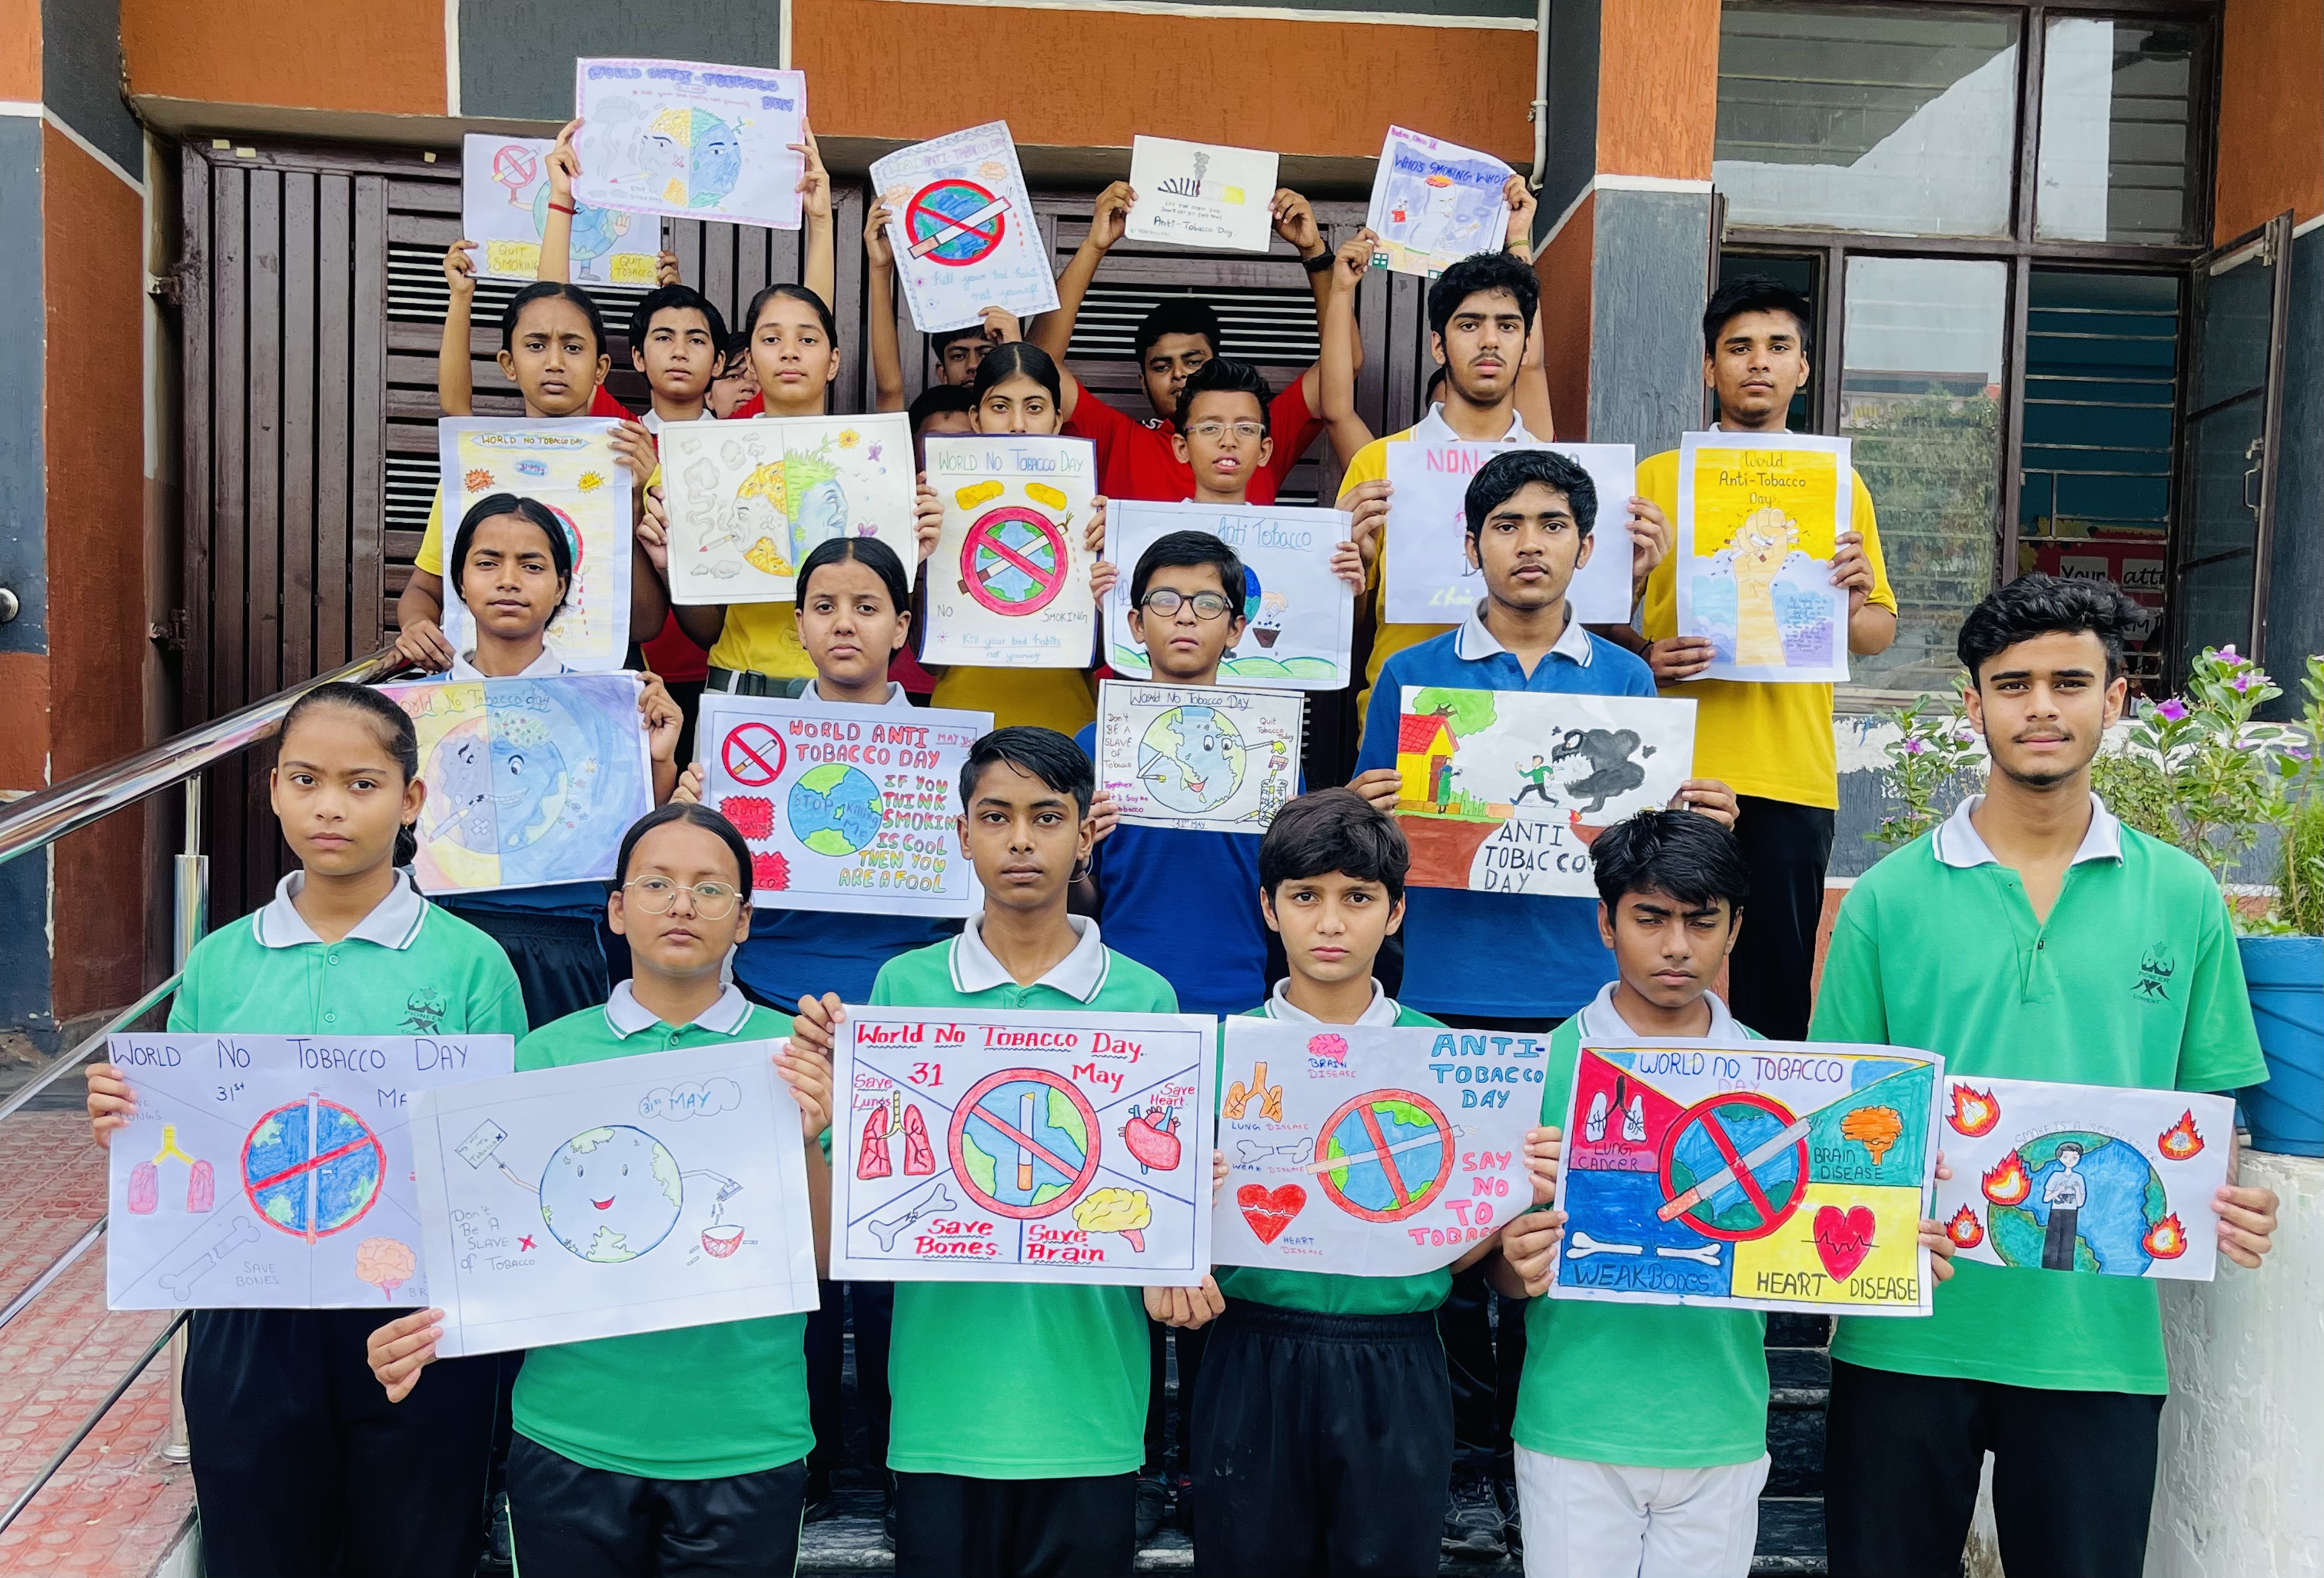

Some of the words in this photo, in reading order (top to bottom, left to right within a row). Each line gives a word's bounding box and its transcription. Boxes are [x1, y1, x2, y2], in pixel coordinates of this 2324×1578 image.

[588, 65, 642, 80] WORLD
[761, 97, 795, 112] DAY
[889, 158, 923, 174] WORLD
[1430, 162, 1472, 181] SMOKING
[498, 245, 525, 255] QUIT
[620, 256, 641, 265] QUIT
[615, 268, 653, 278] TOBACCO
[933, 271, 953, 285] Kill
[961, 275, 986, 290] your
[481, 434, 517, 444] WORLD
[939, 451, 977, 471] WORLD
[986, 451, 1002, 471] NO
[1009, 449, 1056, 471] TOBACCO
[1060, 451, 1083, 472] DAY
[1742, 452, 1783, 468] World
[1750, 493, 1777, 508] Day
[1216, 516, 1248, 545] Anti
[1252, 518, 1312, 548] Tobacco
[937, 605, 953, 617] NO
[1040, 608, 1087, 624] SMOKING
[963, 634, 979, 645] Kill
[985, 638, 1006, 650] your
[1012, 635, 1027, 645] bad
[1033, 634, 1061, 645] habits
[1006, 652, 1041, 665] yourself
[394, 694, 434, 713] orld
[447, 693, 461, 709] No
[467, 689, 523, 705] Tobacco
[1167, 692, 1181, 703] No
[1186, 693, 1222, 705] Tobacco
[1228, 695, 1249, 711] DAY
[1107, 713, 1129, 722] Don't
[790, 720, 860, 741] WORLD
[872, 724, 929, 748] ANTI
[1105, 724, 1118, 734] BE
[1124, 725, 1130, 734] A
[1105, 737, 1132, 747] SLAVE
[795, 743, 890, 765] TOBACCO
[899, 750, 940, 769] DAY
[1104, 760, 1132, 768] Tobacco
[884, 774, 908, 788] IF
[916, 776, 948, 794] YOU
[729, 804, 760, 816] QUIT
[795, 794, 833, 812] STOP
[883, 792, 947, 811] THINK
[1499, 820, 1565, 846] ANTI
[876, 833, 899, 850] IS
[903, 834, 948, 856] COOL
[859, 850, 903, 869] THEN
[912, 853, 946, 874] YOU
[839, 868, 873, 887] ARE
[879, 870, 891, 887] A
[894, 871, 947, 894] FOOL
[1485, 870, 1531, 893] DAY
[856, 1024, 925, 1044] World
[934, 1023, 966, 1044] No
[111, 1041, 181, 1067] WORLD
[217, 1040, 251, 1069] NO
[286, 1038, 386, 1071] TOBACCO
[415, 1038, 469, 1071] DAY
[1308, 1058, 1348, 1069] BRAIN
[1308, 1069, 1356, 1079] DISEASE
[1429, 1064, 1544, 1084] TOBACCO
[1641, 1053, 1704, 1075] WORLD
[1751, 1057, 1844, 1083] TOBACCO
[853, 1074, 893, 1089] Save
[907, 1063, 945, 1088] 31
[1072, 1064, 1125, 1094] May
[1718, 1079, 1760, 1094] DAY
[1160, 1083, 1195, 1096] Save
[669, 1090, 711, 1110] MAY
[1461, 1089, 1511, 1109] DAY
[1232, 1121, 1261, 1130] LUNG
[2015, 1124, 2050, 1146] SMOKE
[2053, 1120, 2066, 1130] IS
[2073, 1121, 2080, 1130] A
[2090, 1124, 2125, 1139] SERIAL
[1462, 1151, 1512, 1172] SAY
[1814, 1147, 1857, 1164] BRAIN
[1820, 1165, 1884, 1180] DISEASE
[1473, 1177, 1509, 1197] NO
[451, 1204, 491, 1222] Don't
[1445, 1199, 1494, 1226] TO
[458, 1223, 479, 1237] Be
[487, 1219, 500, 1233] A
[928, 1218, 994, 1237] Save
[1028, 1224, 1088, 1242] Save
[467, 1237, 510, 1249] SLAVE
[242, 1261, 276, 1274] SAVE
[484, 1257, 536, 1272] TOBACCO
[235, 1275, 280, 1287] BONES
[1574, 1263, 1647, 1288] WEAK
[1757, 1271, 1827, 1297] HEART
[1850, 1276, 1918, 1302] DISEASE
